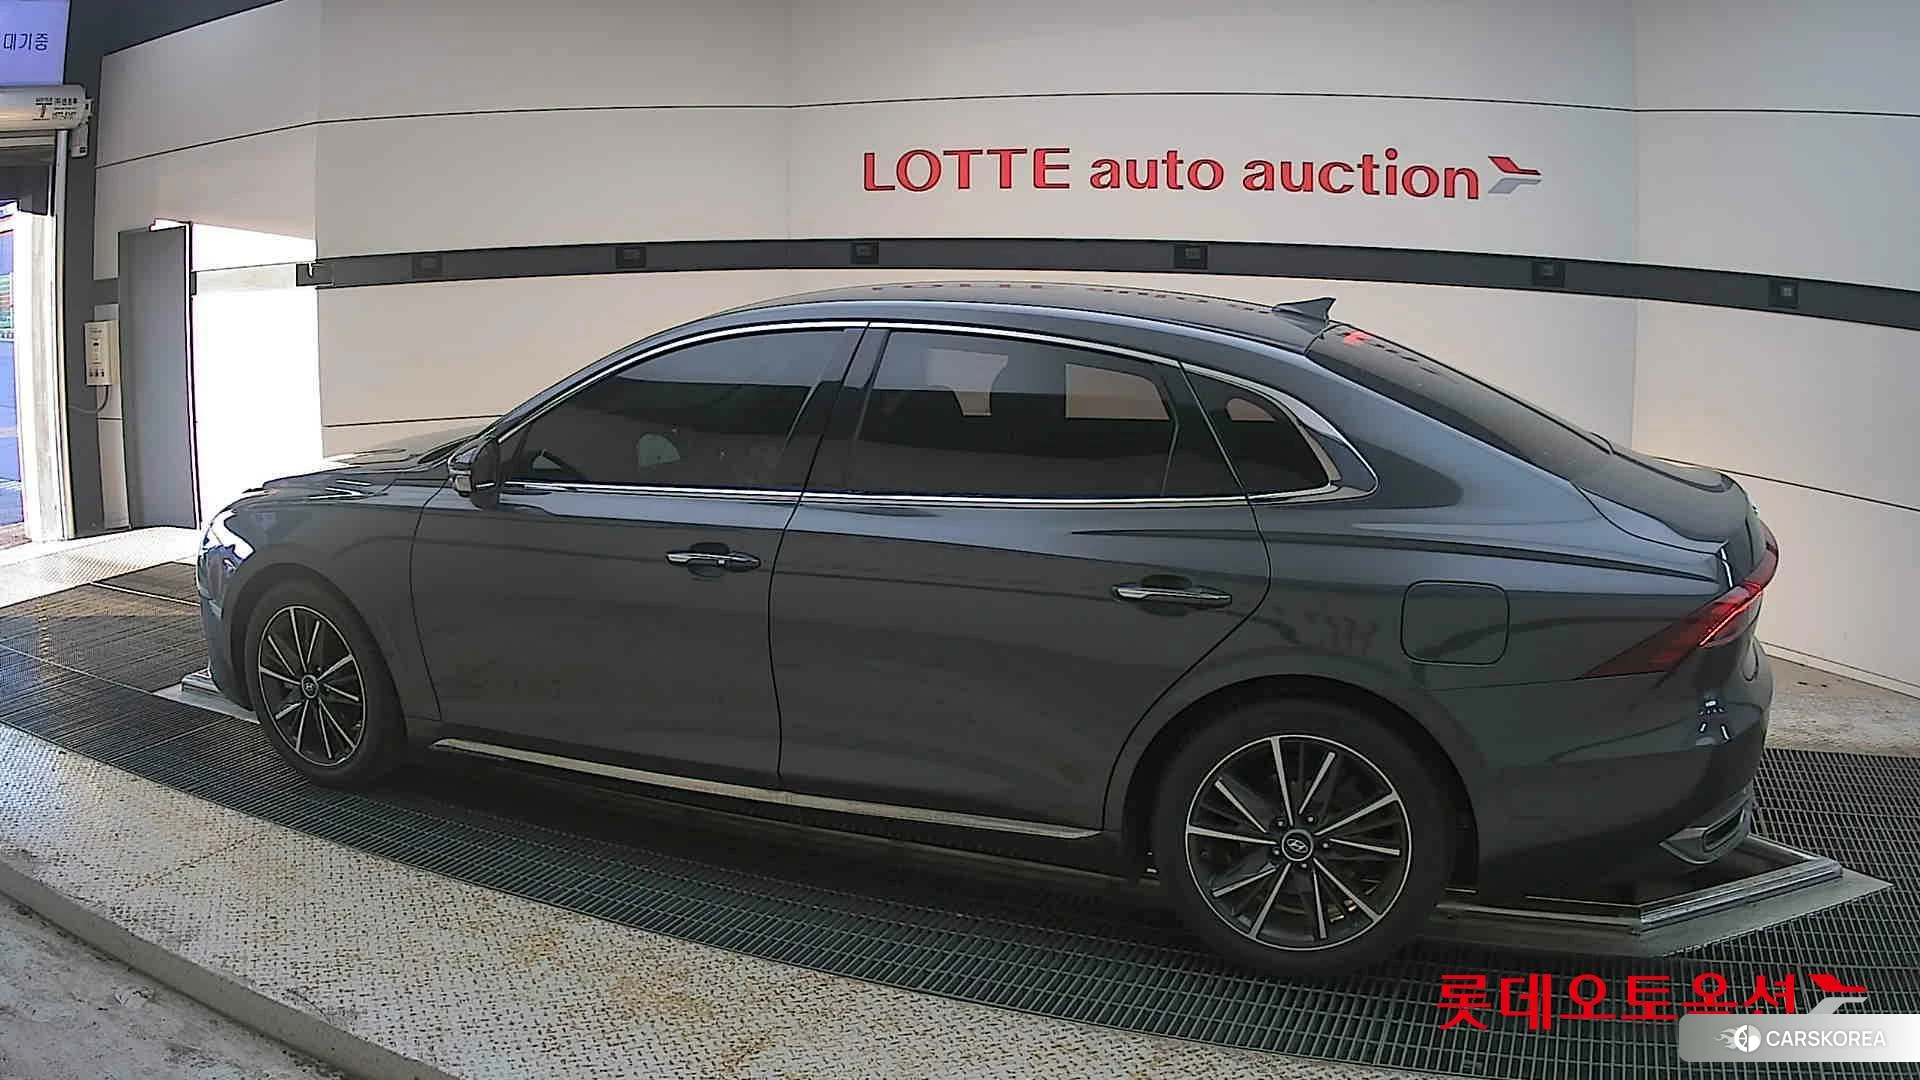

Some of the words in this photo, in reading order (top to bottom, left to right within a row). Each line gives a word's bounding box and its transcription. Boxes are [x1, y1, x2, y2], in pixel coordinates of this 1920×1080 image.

[3, 32, 49, 52] 대기중
[864, 147, 1070, 192] LOTTE
[1090, 150, 1225, 191] auto
[1242, 149, 1481, 199] auction
